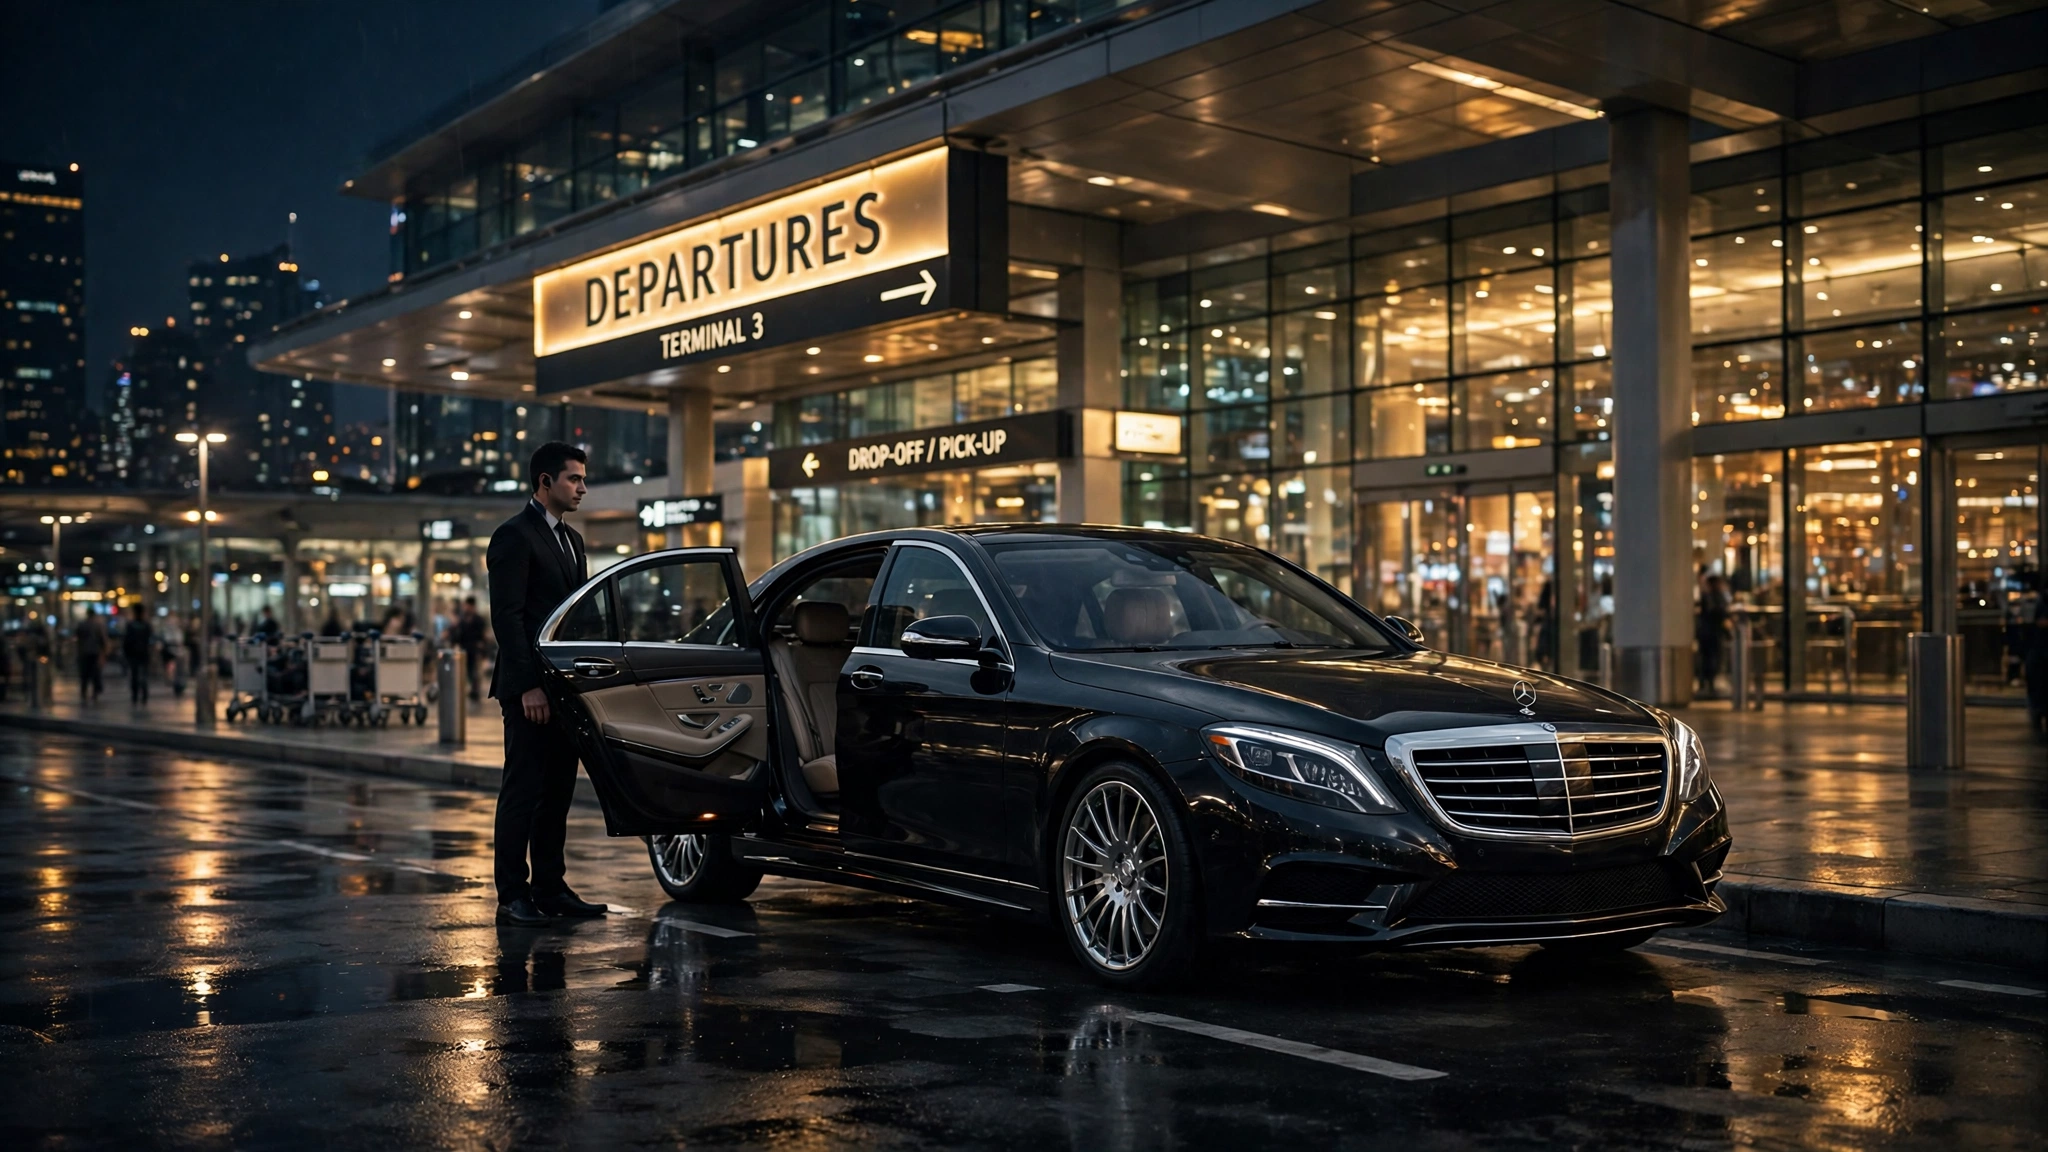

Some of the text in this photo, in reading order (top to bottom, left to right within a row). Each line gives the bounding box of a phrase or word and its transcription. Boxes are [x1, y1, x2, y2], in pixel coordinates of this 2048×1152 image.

[586, 192, 880, 328] DEPARTURES
[659, 311, 764, 360] TERMINAL 3
[848, 429, 1007, 471] DROP-OFF / PICK-UP
